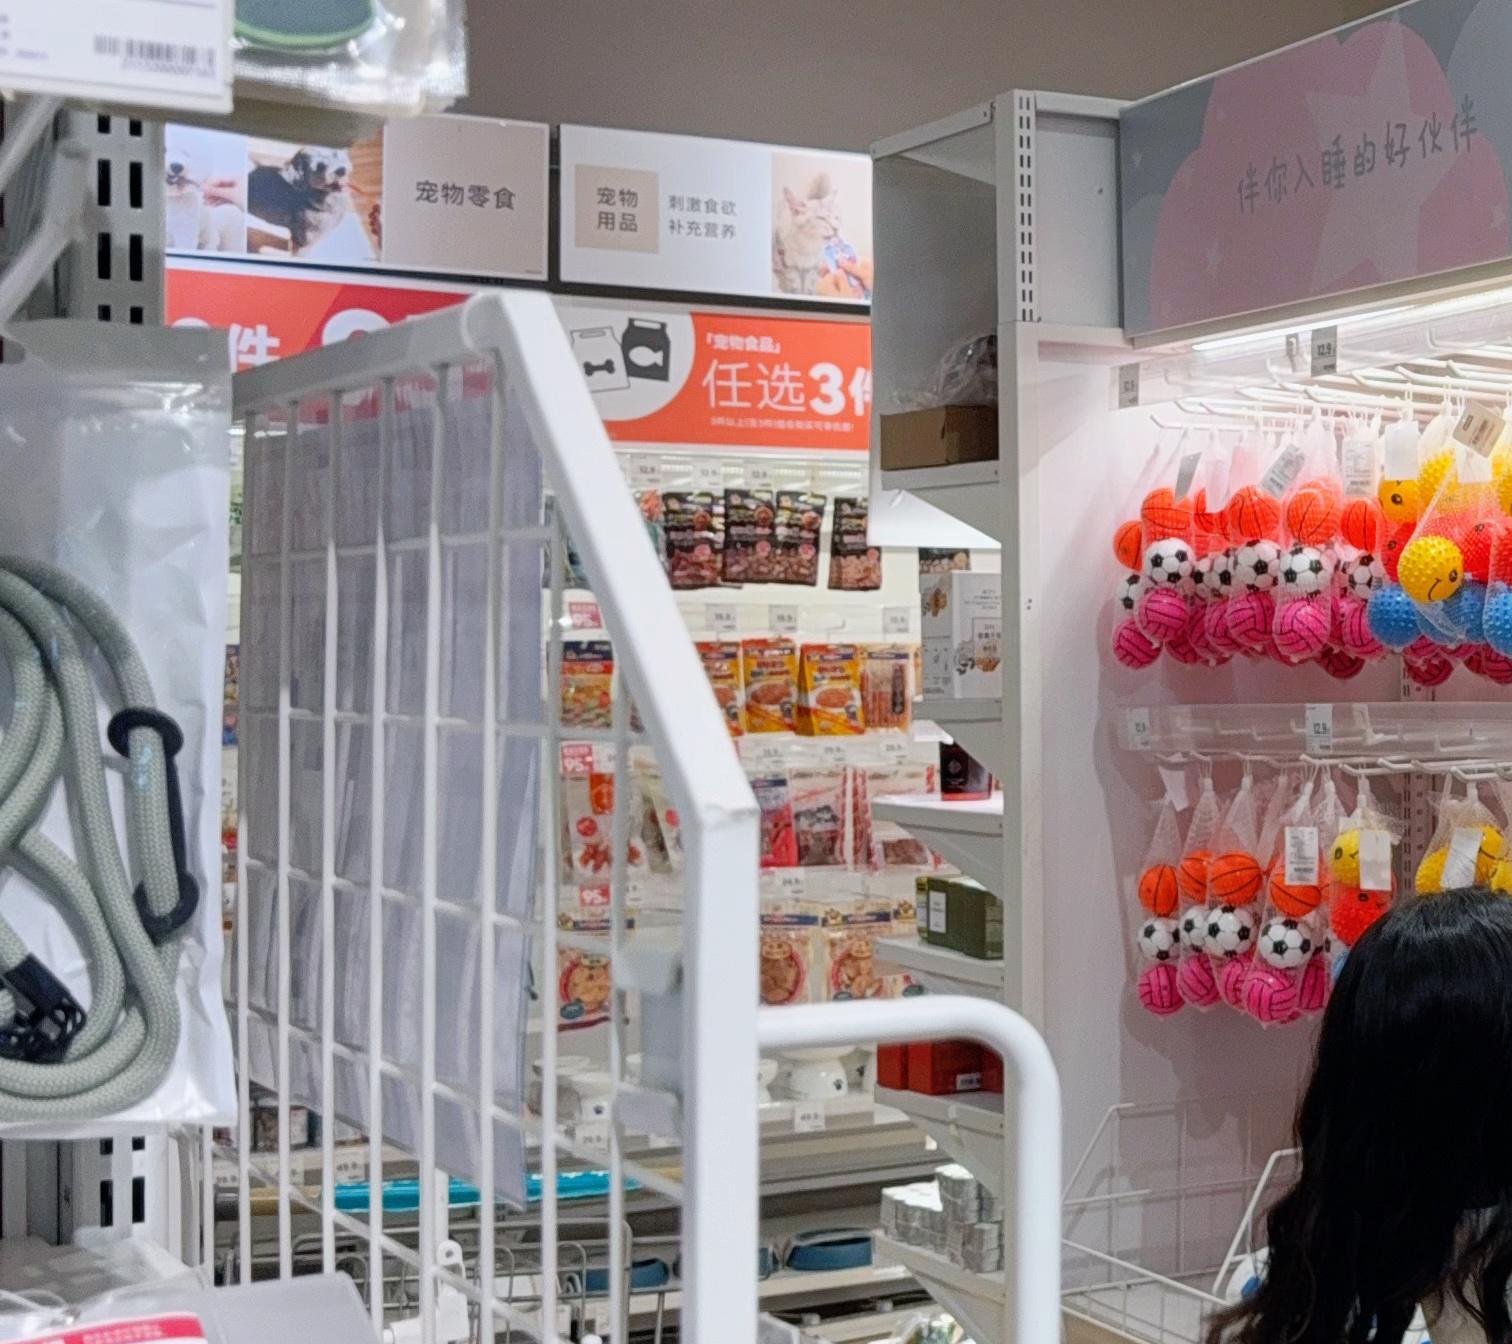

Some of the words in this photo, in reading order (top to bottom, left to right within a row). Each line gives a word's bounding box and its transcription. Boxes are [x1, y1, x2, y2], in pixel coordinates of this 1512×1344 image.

[1237, 92, 1478, 215] 伴你入睡的好伙伴
[414, 179, 517, 212] 宠物零食
[596, 186, 640, 209] 宠物
[667, 194, 738, 218] 刺激食欲
[596, 210, 640, 233] 用品
[667, 218, 737, 241] 补充营养
